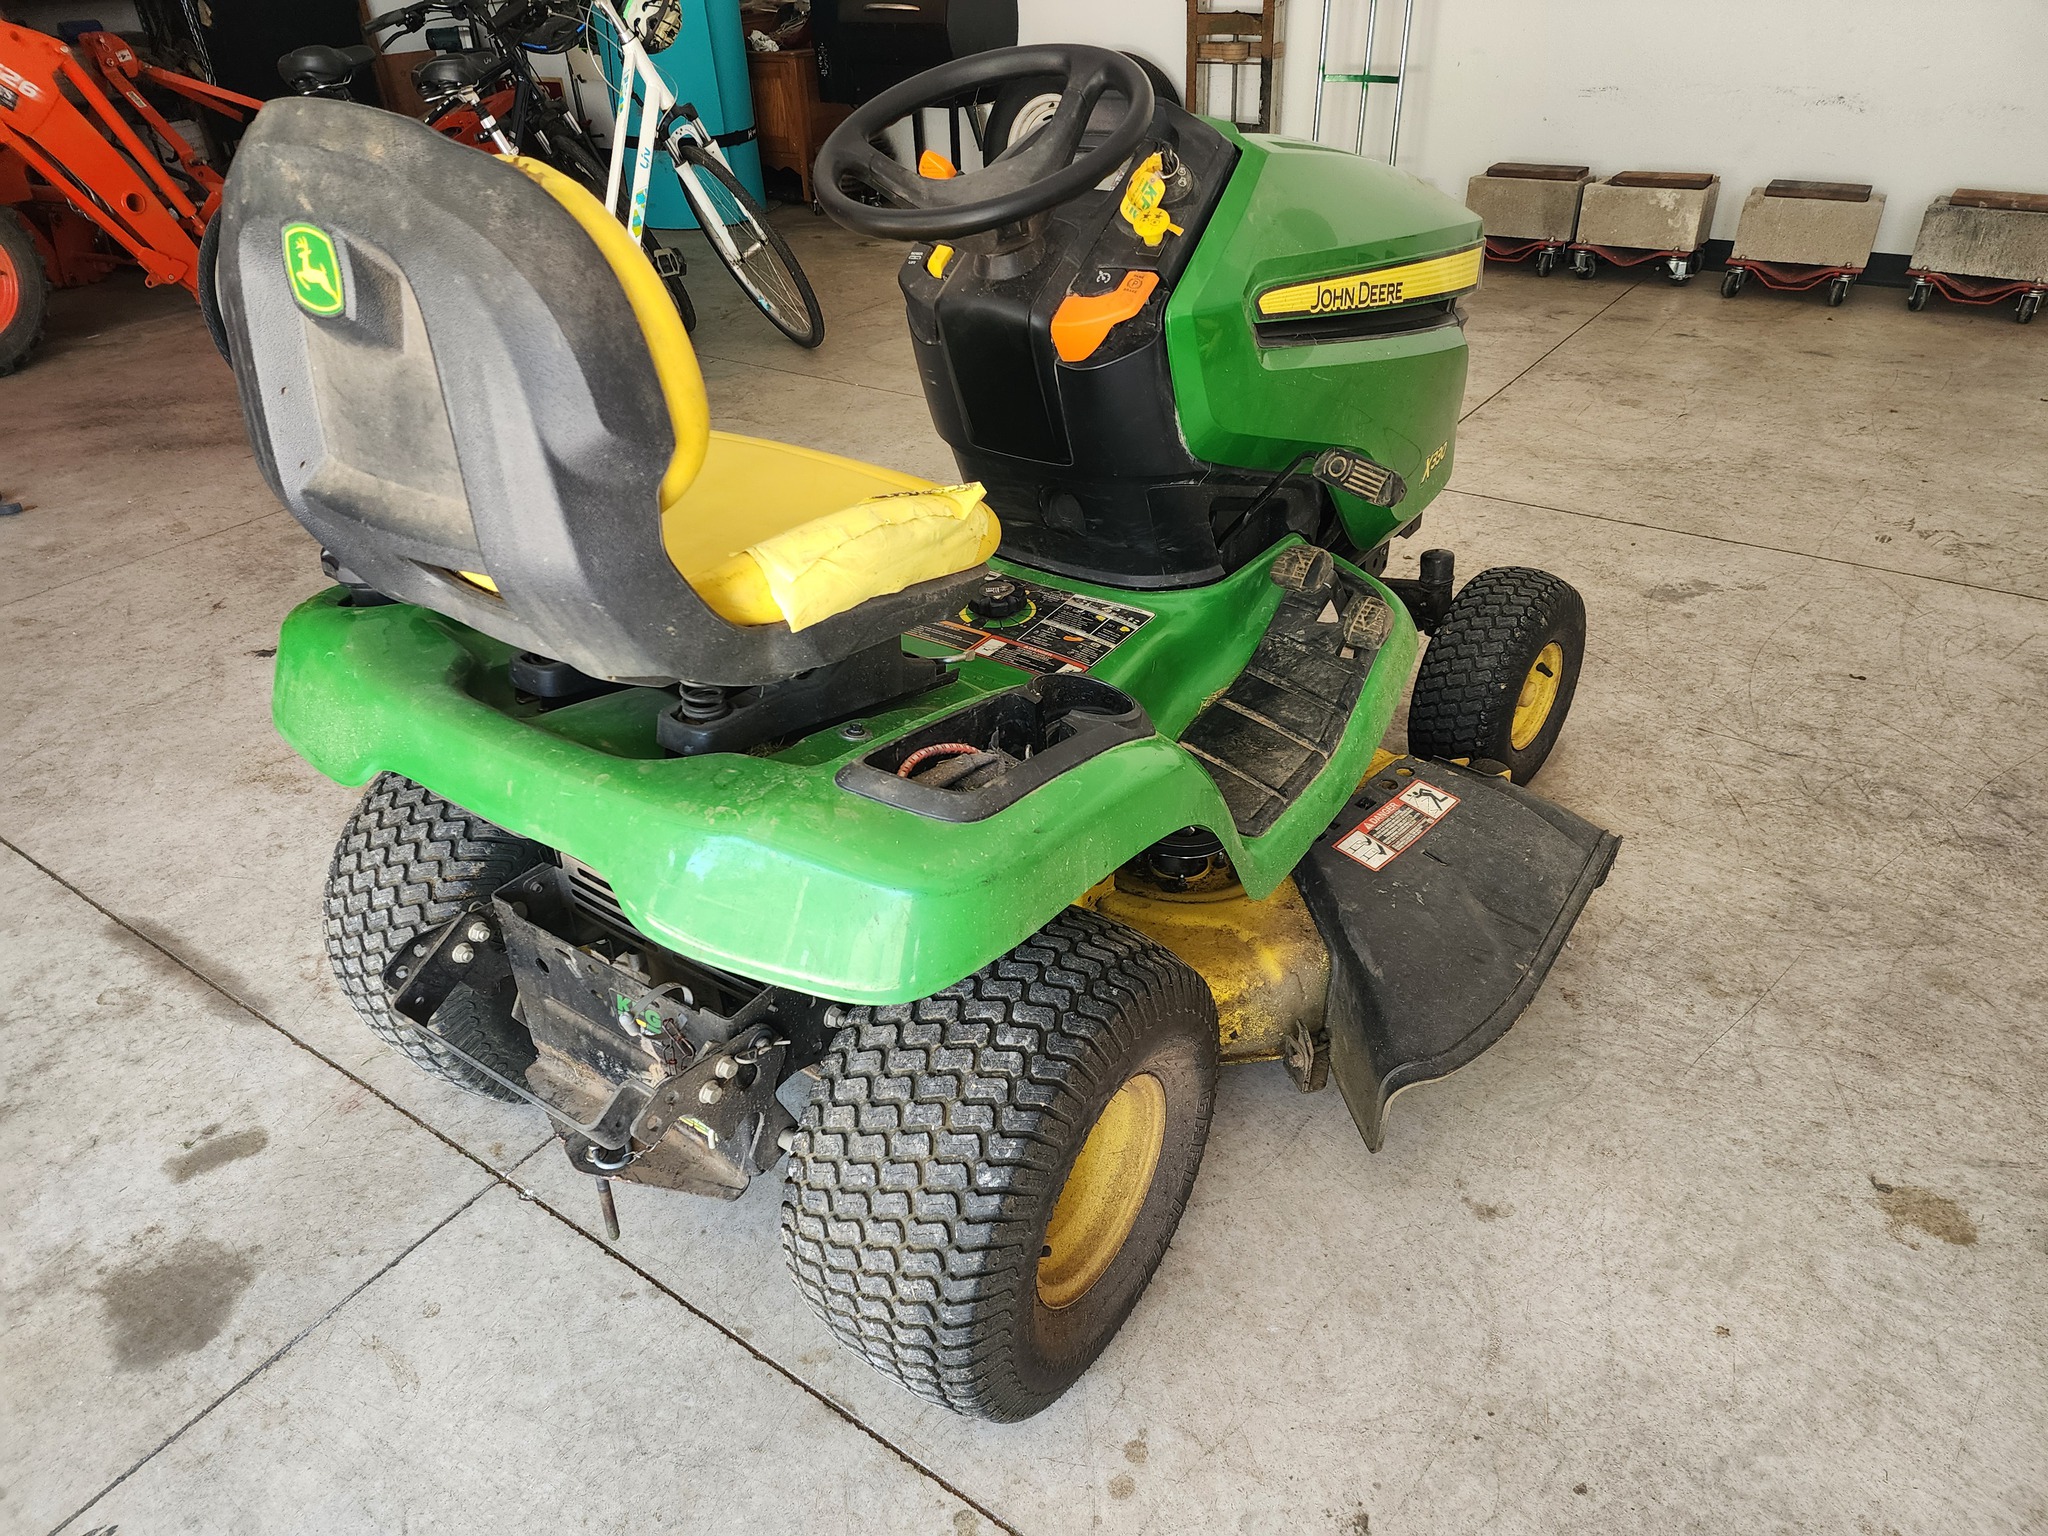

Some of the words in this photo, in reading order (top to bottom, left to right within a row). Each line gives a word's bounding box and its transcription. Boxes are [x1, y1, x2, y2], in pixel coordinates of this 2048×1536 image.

[640, 147, 652, 170] Liv
[1310, 285, 1356, 312] JOHN
[1358, 281, 1404, 307] DEERE
[1369, 802, 1400, 824] DANGER
